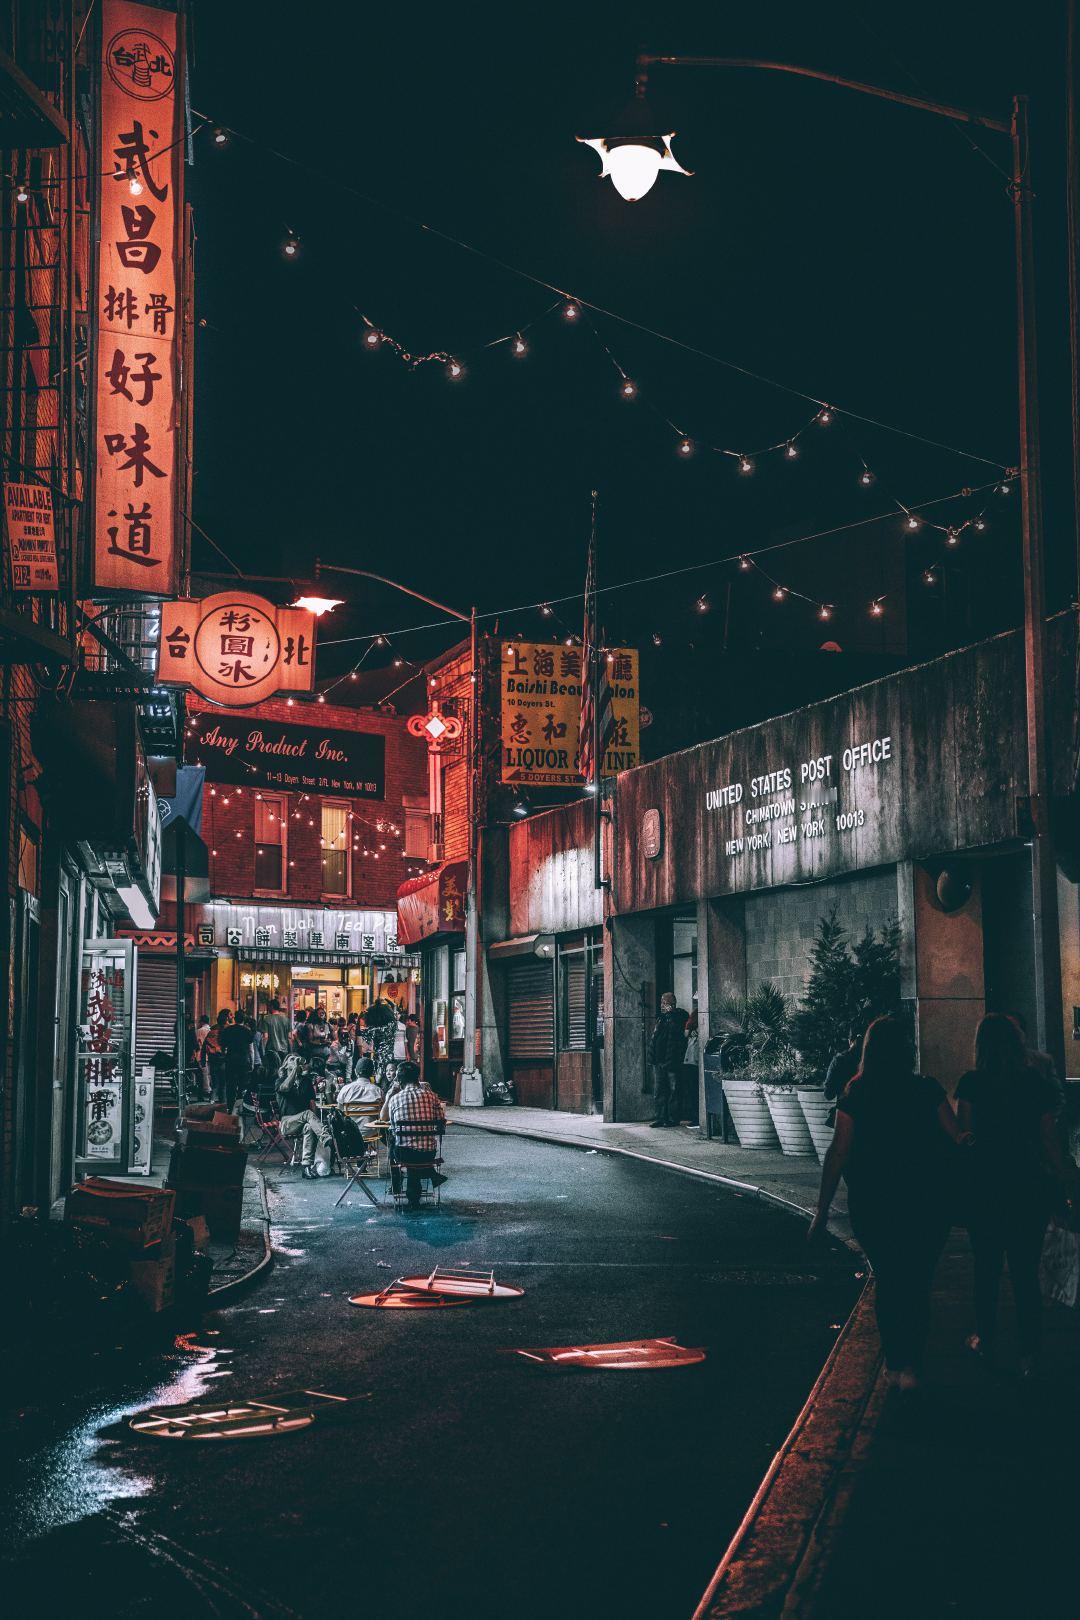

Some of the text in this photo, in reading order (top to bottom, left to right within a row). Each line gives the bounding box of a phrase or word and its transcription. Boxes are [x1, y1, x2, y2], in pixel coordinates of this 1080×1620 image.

[7, 486, 52, 511] AVAILABLE
[506, 678, 547, 694] Baishi
[517, 700, 543, 709] Doyers
[545, 700, 556, 708] St.
[200, 726, 349, 763] Any Product Inc.
[506, 748, 569, 770] LIQUOR
[520, 773, 577, 783] 5 DOYERS ST.
[705, 783, 743, 811] UNITED
[750, 768, 792, 798] STATES
[801, 755, 832, 783] POST
[842, 737, 892, 771] OFFICE
[745, 798, 795, 825] CHINATOWN
[726, 809, 865, 856] NEW YORK, NEW YORK 10013
[282, 910, 315, 932] Wah
